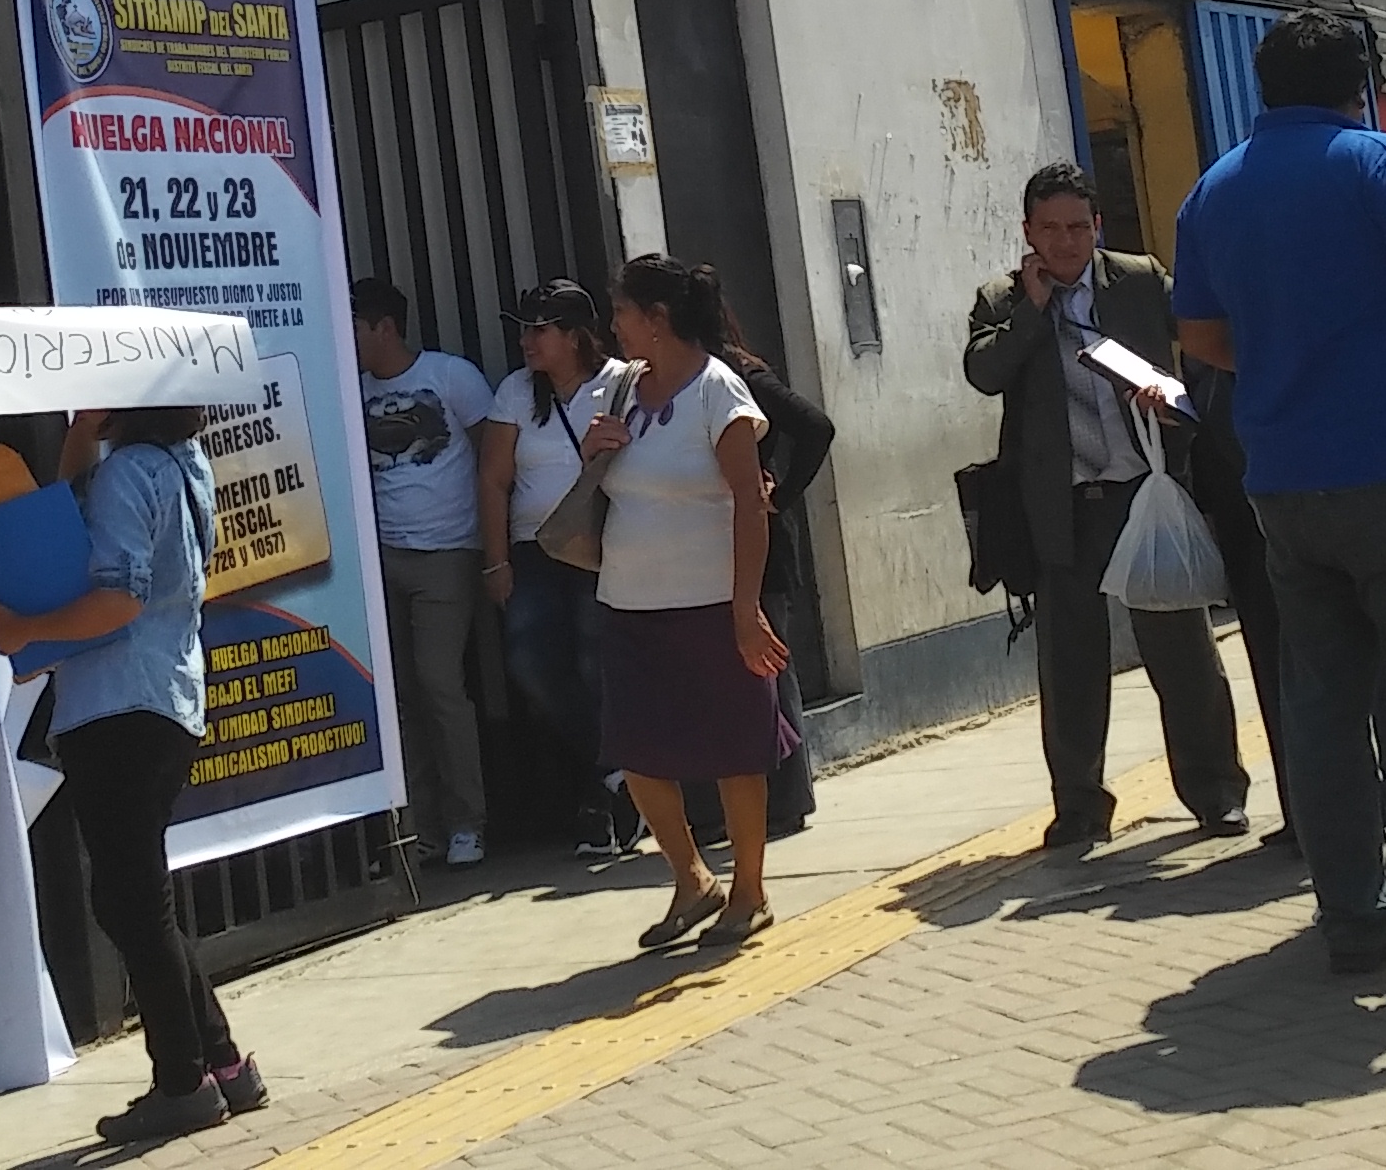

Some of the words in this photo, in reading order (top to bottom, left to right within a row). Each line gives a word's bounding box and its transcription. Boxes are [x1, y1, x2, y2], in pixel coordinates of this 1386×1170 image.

[209, 9, 233, 37] DEL
[232, 0, 290, 41] SANTA
[70, 110, 167, 153] HUELGA
[173, 115, 293, 156] NACIONAL
[120, 176, 160, 223] 21,
[167, 176, 202, 219] 22
[206, 190, 219, 222] y
[223, 177, 256, 219] 23
[116, 237, 137, 271] de
[141, 231, 280, 271] NOVIEMBRE
[143, 285, 220, 307] PRESUPUESTO
[221, 284, 255, 304] DIGNO
[254, 283, 264, 303] Y
[246, 306, 280, 329] ÚNETE
[281, 309, 290, 327] A
[292, 308, 304, 326] LA
[274, 462, 305, 495] DEL
[220, 502, 283, 545] FISCAL.
[212, 551, 237, 575] 728
[249, 531, 286, 560] 1057)
[210, 640, 260, 673] HUELGA
[261, 625, 331, 662] NACIONAL!
[205, 676, 244, 710] BAJO
[243, 675, 262, 700] EL
[262, 667, 298, 698] MEF!
[218, 709, 269, 743] UNIDAD
[270, 693, 336, 730] SINDICAL!
[189, 739, 290, 787] SINDICALISMO
[291, 720, 367, 761] PROACTIVO!
